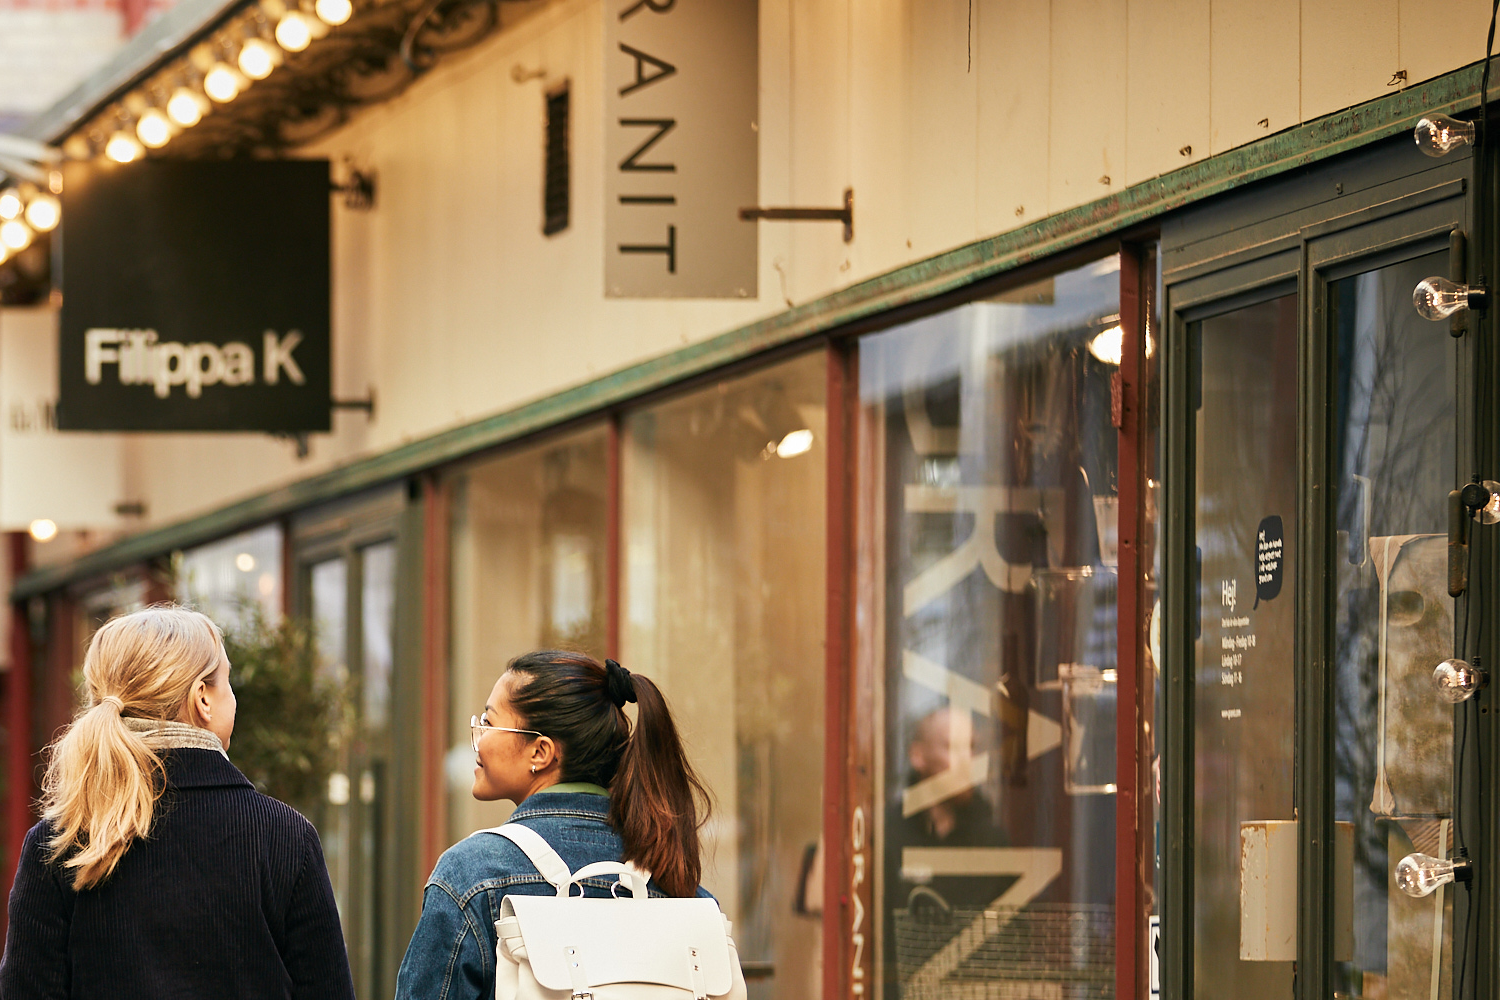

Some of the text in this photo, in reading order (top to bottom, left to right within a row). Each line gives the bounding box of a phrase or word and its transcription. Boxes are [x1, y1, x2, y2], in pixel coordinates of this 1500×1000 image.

[84, 327, 306, 398] Filippa K
[1221, 579, 1237, 613] Hej!
